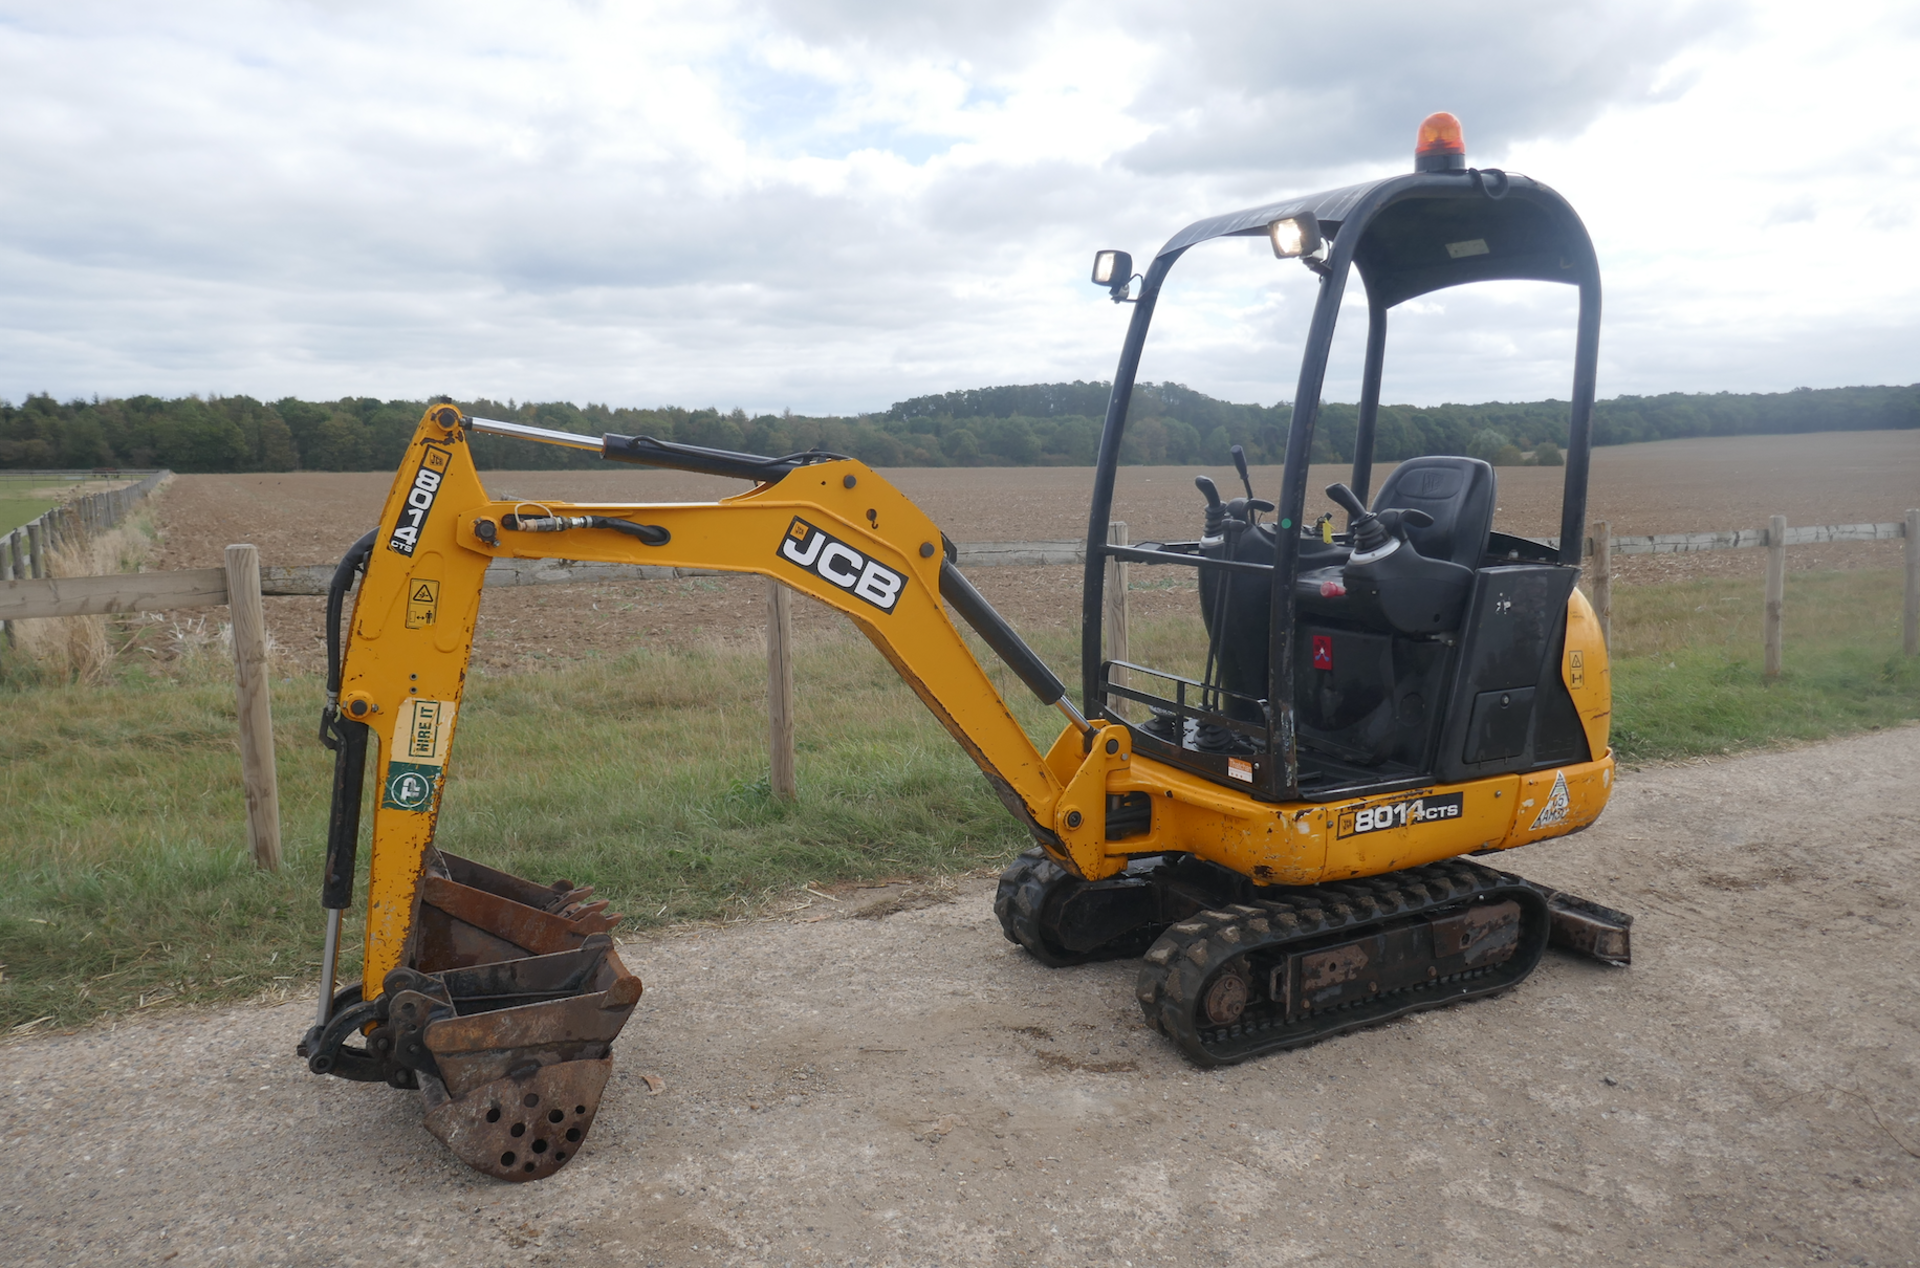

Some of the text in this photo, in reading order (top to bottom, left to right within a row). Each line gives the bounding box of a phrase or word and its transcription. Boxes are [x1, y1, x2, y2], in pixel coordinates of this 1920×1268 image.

[394, 469, 441, 546] 8014
[390, 540, 413, 553] CTS
[783, 532, 902, 609] JCB
[416, 706, 434, 752] HIRE IT
